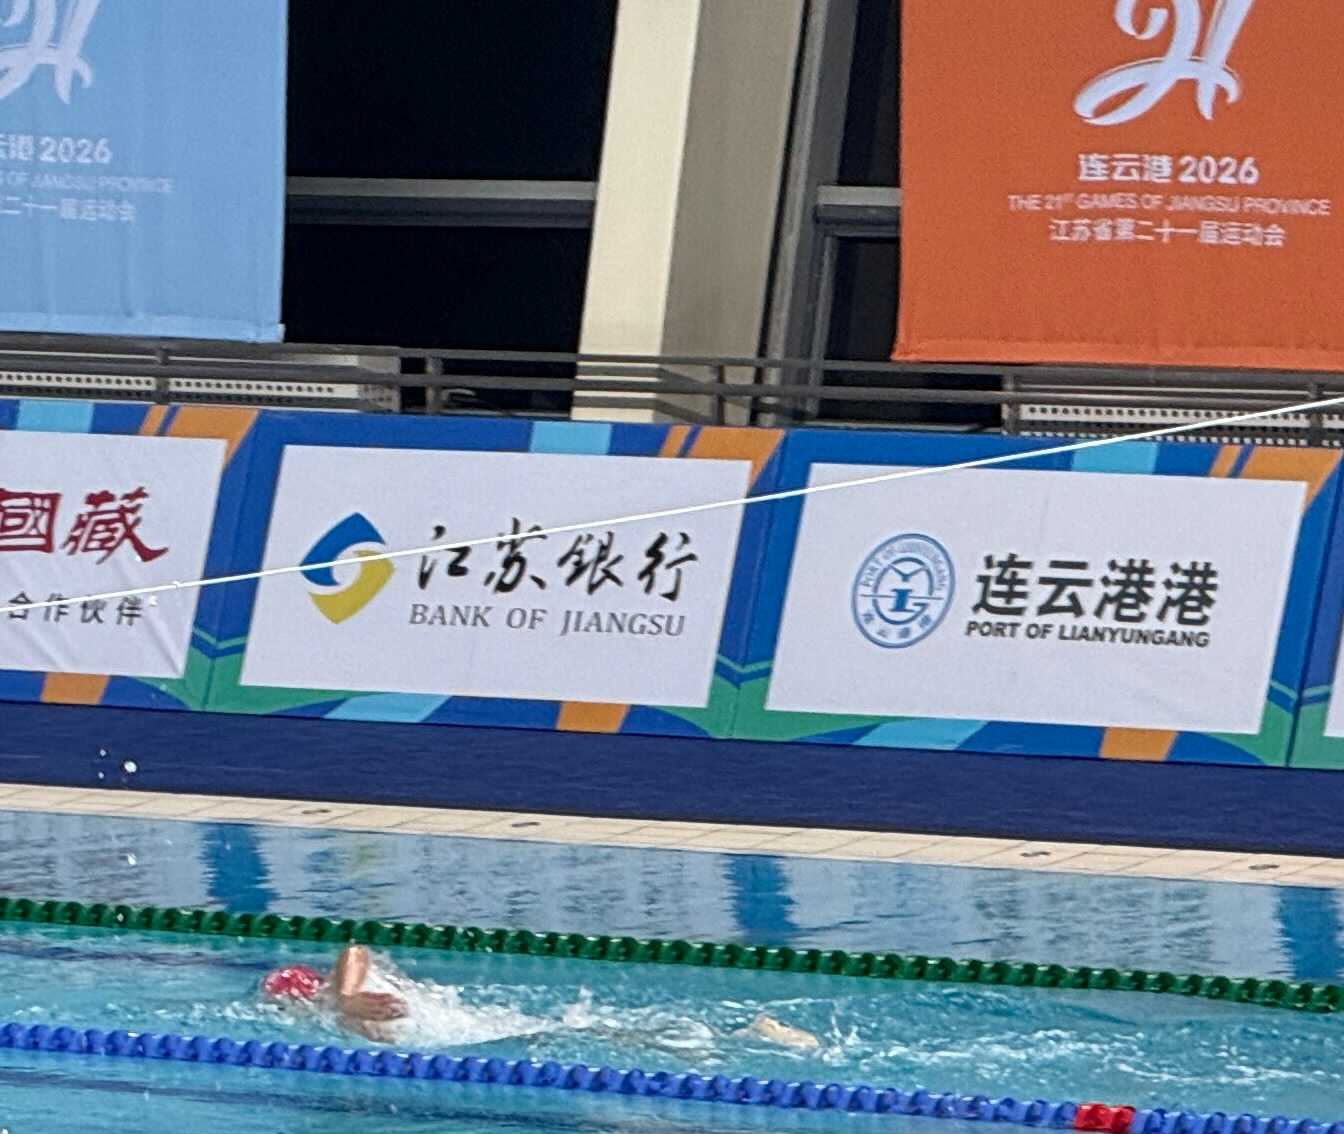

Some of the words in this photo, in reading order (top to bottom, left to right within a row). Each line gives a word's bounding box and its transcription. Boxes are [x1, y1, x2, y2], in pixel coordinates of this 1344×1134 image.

[39, 136, 112, 164] 2026
[1077, 153, 1173, 184] 连云港
[1178, 155, 1260, 185] 2026
[1141, 194, 1163, 210] OF
[1048, 217, 1286, 248] 江苏省第二十一届运动会
[967, 552, 1219, 627] 连云港港
[409, 603, 494, 628] BANK
[506, 607, 548, 630] OF
[560, 609, 686, 637] JIANGSU
[964, 621, 1021, 640] PORT
[1025, 623, 1054, 640] OF
[1057, 624, 1210, 649] LIANYUNGANG
